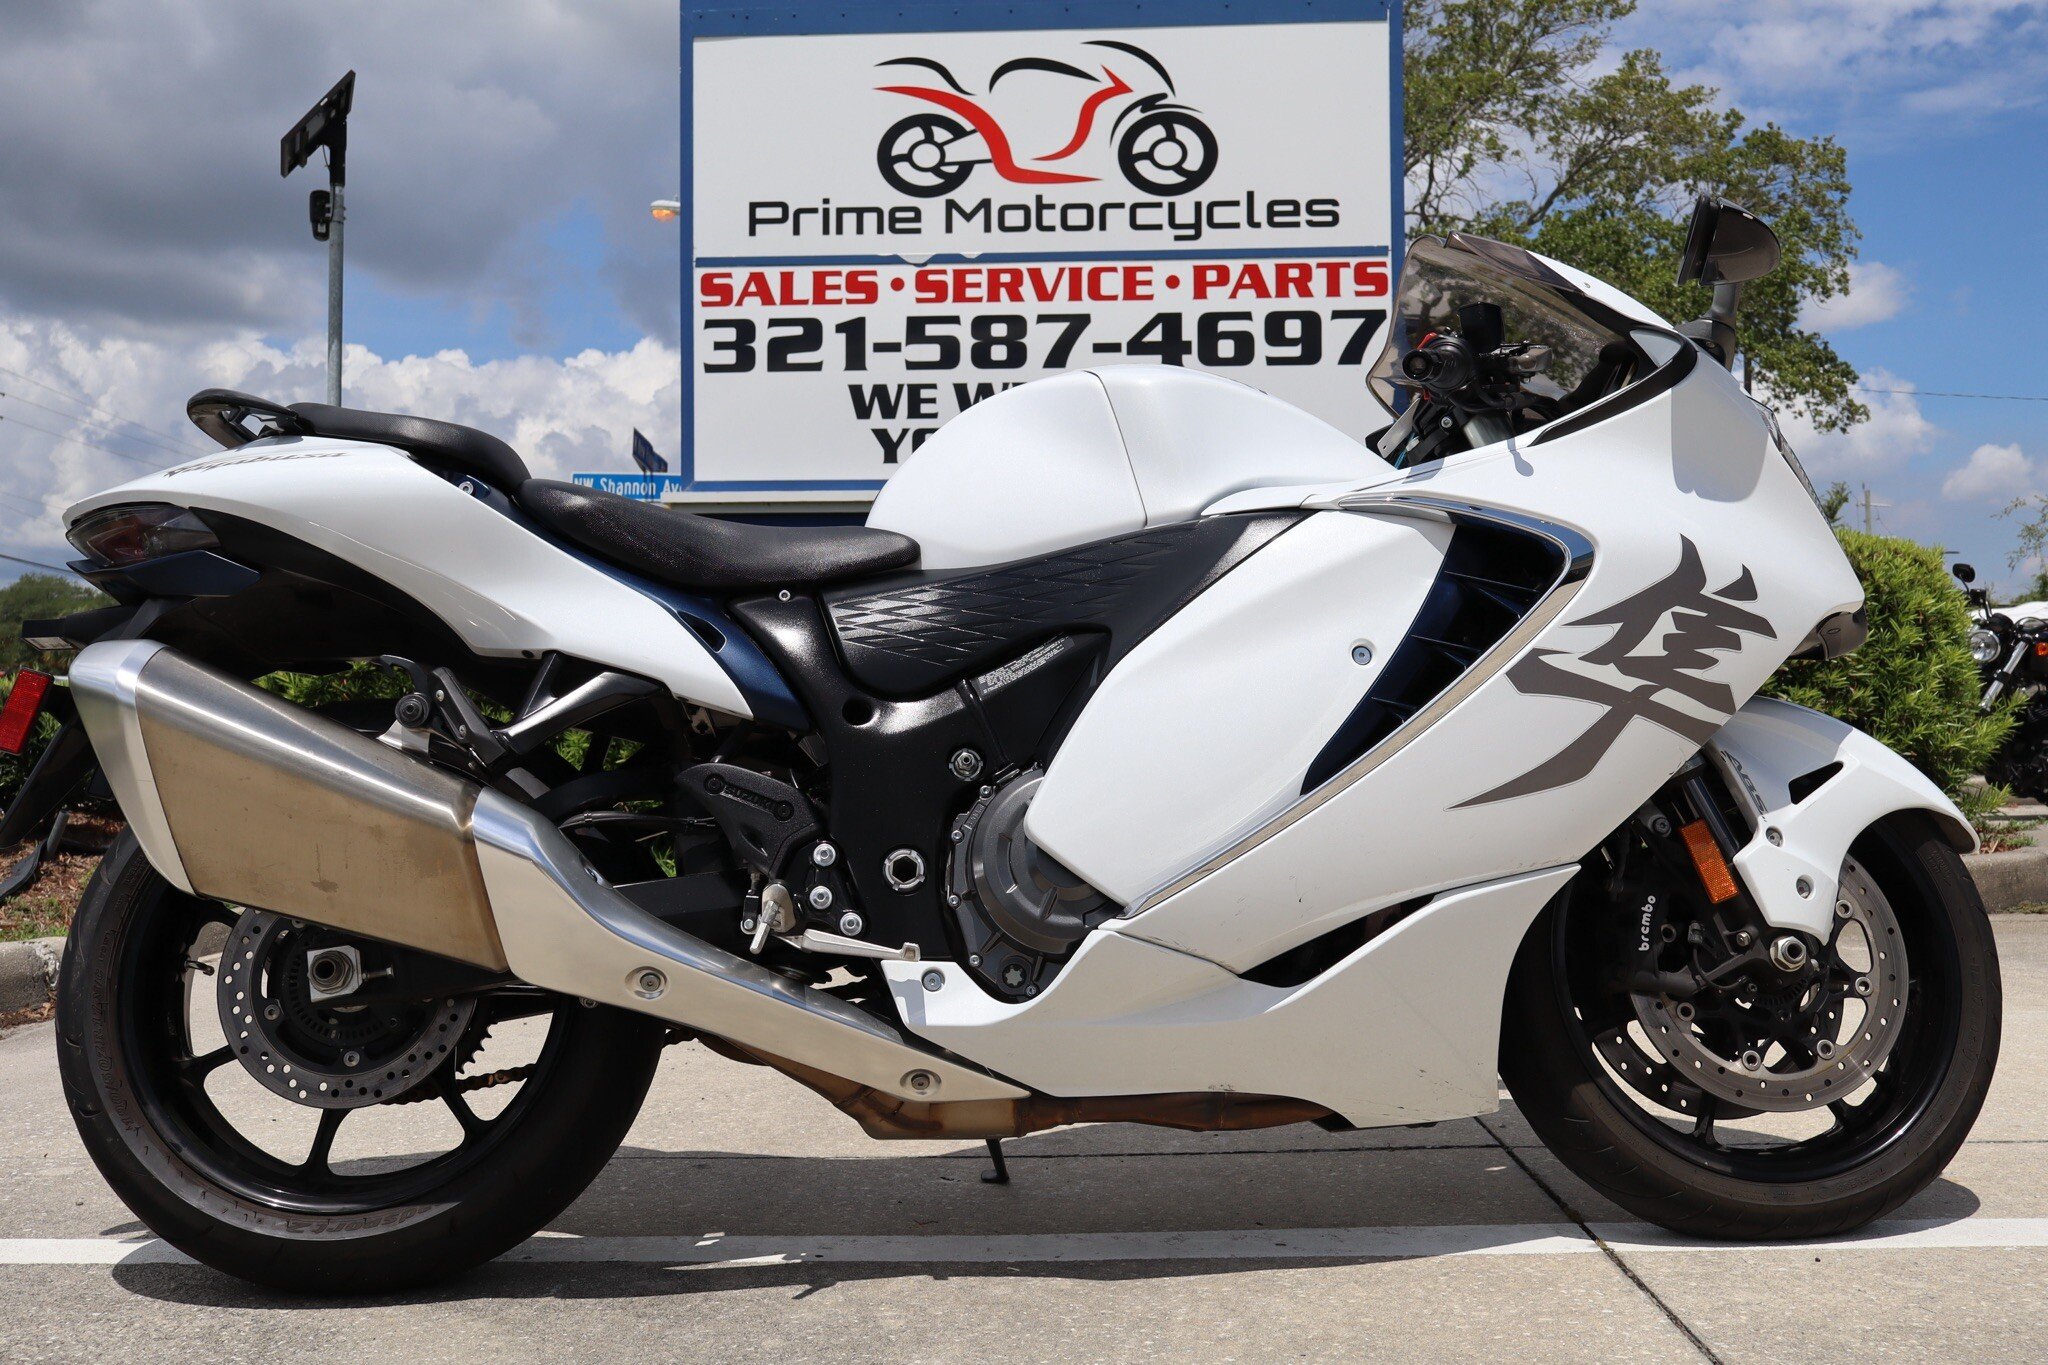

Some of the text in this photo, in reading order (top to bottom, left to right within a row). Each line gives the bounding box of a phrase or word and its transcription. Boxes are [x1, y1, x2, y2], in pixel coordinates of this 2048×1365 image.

[748, 191, 1340, 241] Prime Motorcycles
[701, 261, 1388, 306] SALES SERVICE PARTS
[703, 309, 1387, 373] 321-587-4697
[848, 383, 938, 419] WE
[600, 477, 656, 496] Shannon
[663, 479, 682, 492] Av
[1723, 750, 1769, 816] ABS
[1638, 895, 1656, 951] brembo
